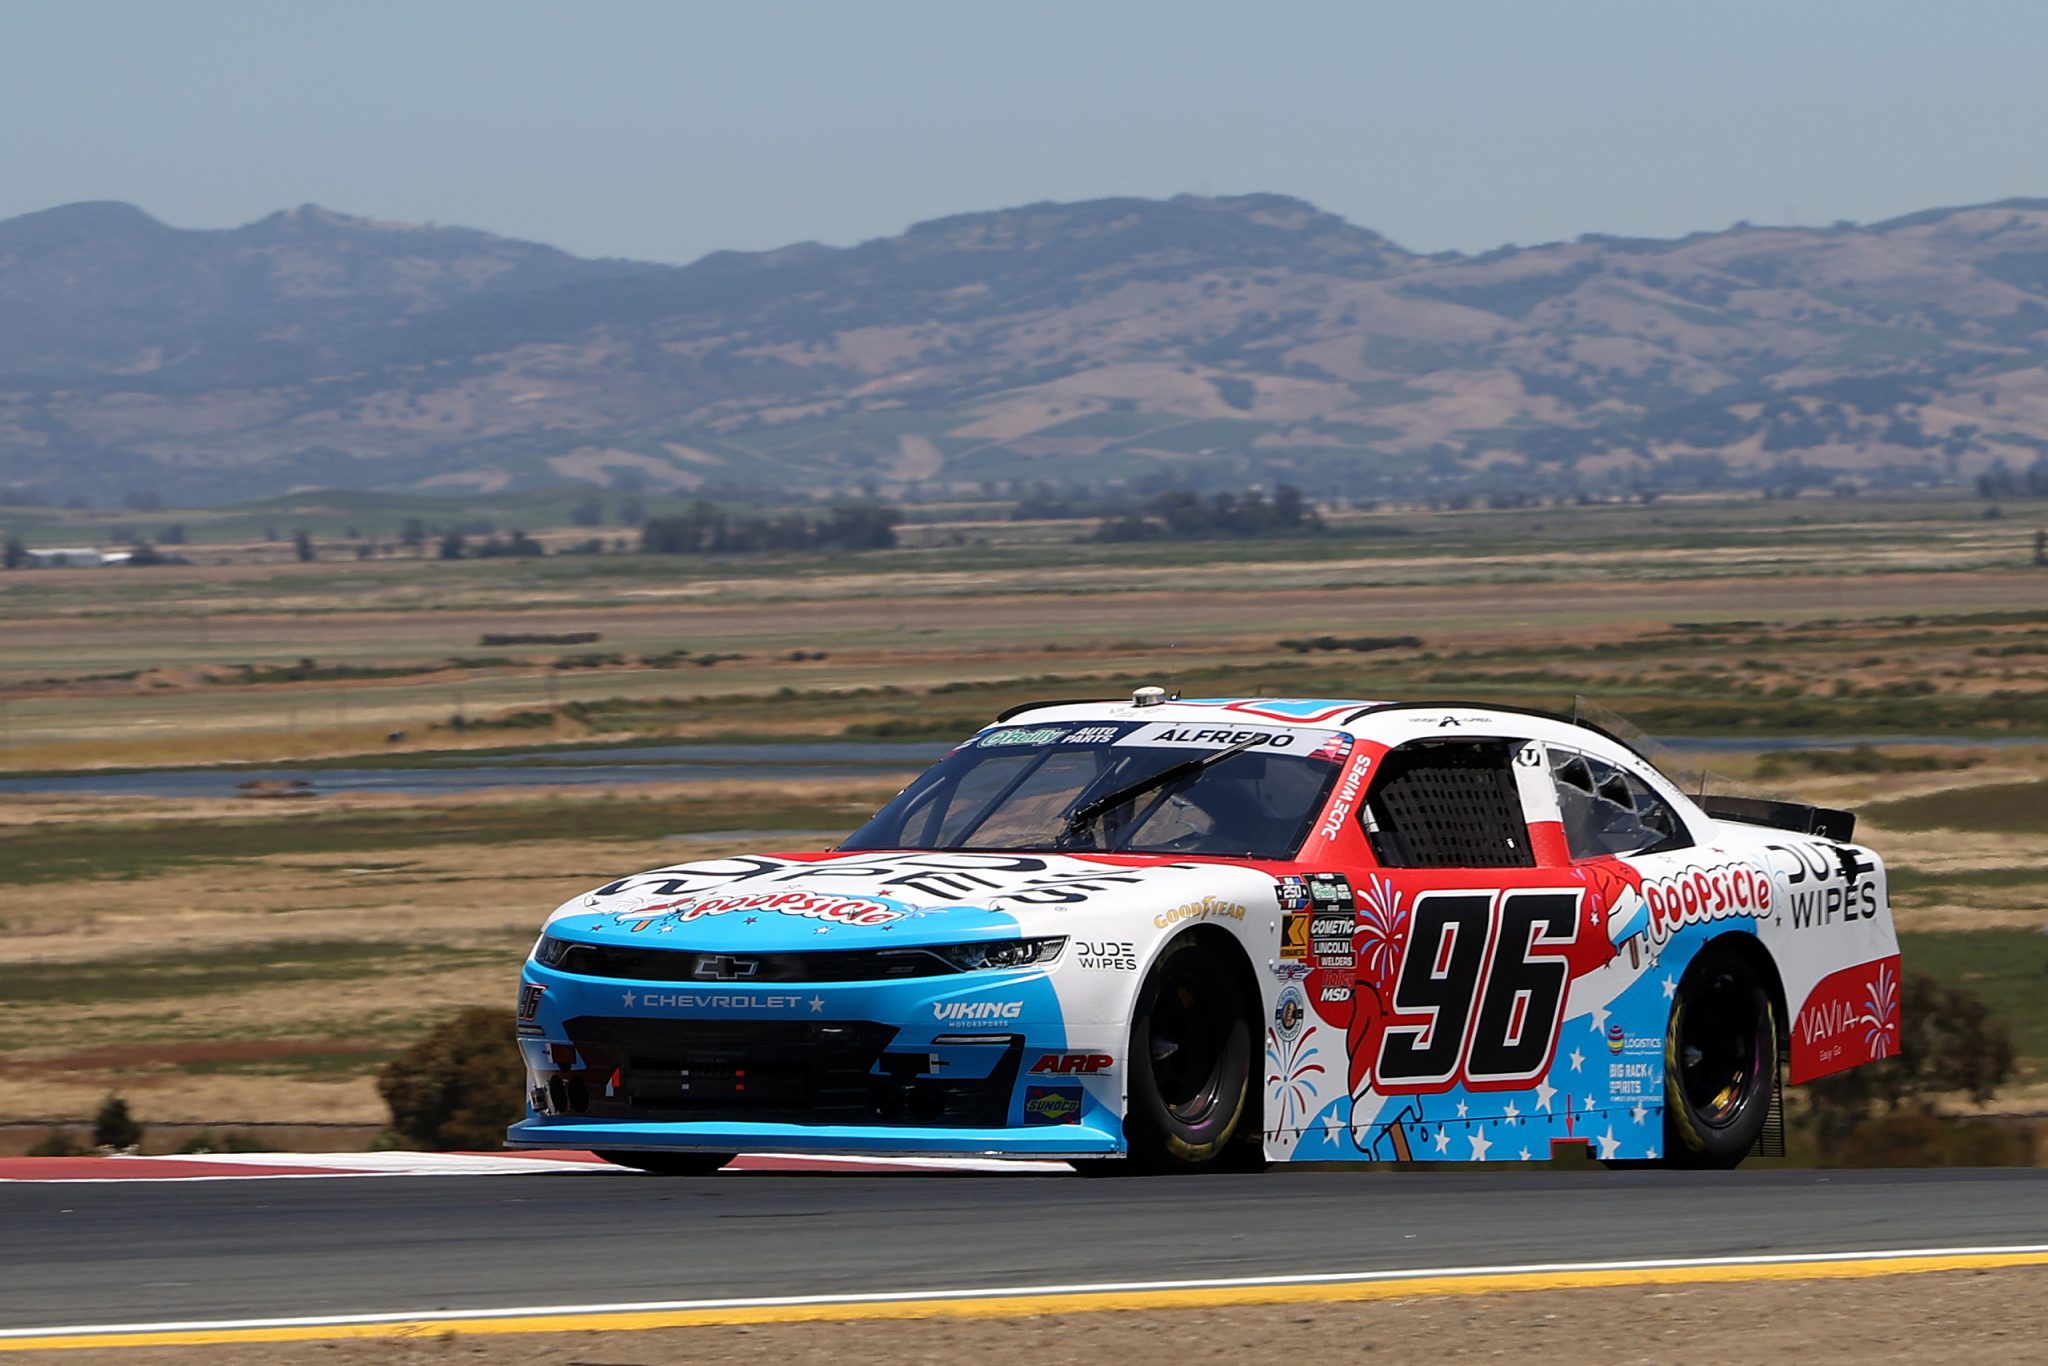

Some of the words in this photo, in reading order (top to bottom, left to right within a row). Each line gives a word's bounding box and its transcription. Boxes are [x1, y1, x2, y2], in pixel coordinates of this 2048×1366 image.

[1074, 727, 1118, 736] AUTO
[1153, 729, 1294, 749] ALFREDO
[1061, 735, 1114, 744] PARTS
[1341, 754, 1372, 802] WIPES
[1154, 896, 1246, 929] GOODYEAR
[1790, 881, 1876, 930] WIPES
[1311, 916, 1355, 935] COMETIC
[1076, 941, 1136, 957] DUDE
[1314, 941, 1349, 954] LINCOLN
[1080, 957, 1137, 970] WIPES
[1320, 955, 1353, 966] WELDERS
[1375, 888, 1585, 1085] 96
[643, 994, 802, 1009] CHEVROLET
[1320, 988, 1350, 1002] MSD
[933, 1001, 1024, 1020] VIKING
[949, 1020, 1009, 1028] MOTORSPORTS
[1029, 1054, 1114, 1074] ARP
[1026, 1099, 1080, 1113] SUNOCO
